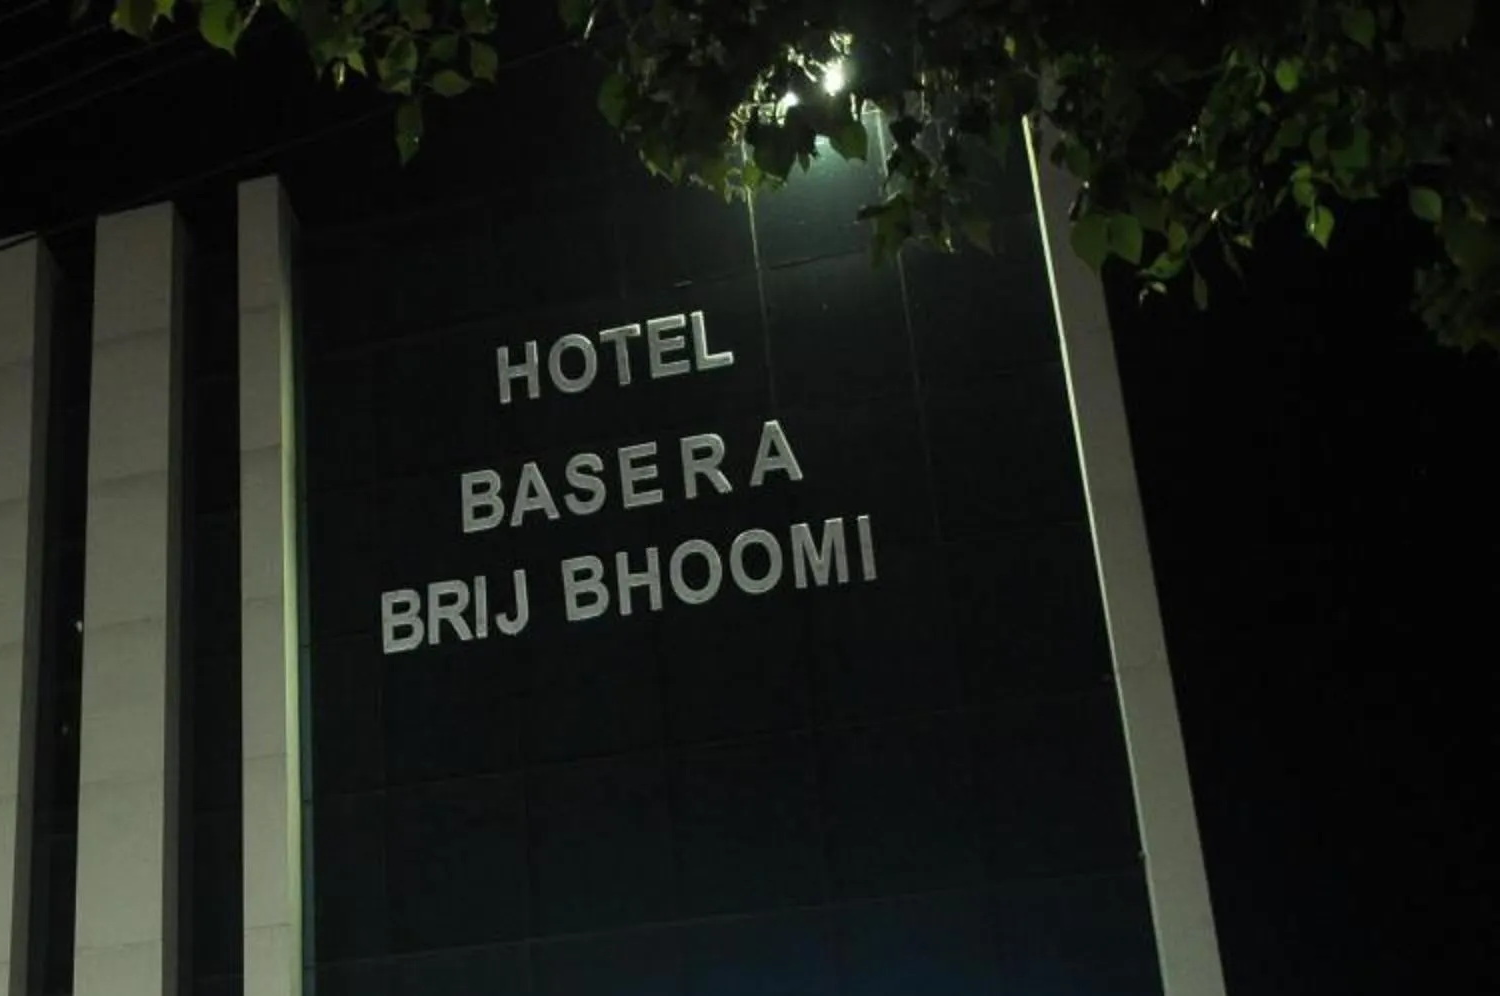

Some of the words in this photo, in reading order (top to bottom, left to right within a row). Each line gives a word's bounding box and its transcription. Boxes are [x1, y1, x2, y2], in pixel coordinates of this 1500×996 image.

[496, 309, 735, 404] HOTEL
[460, 419, 803, 534] BASERA
[380, 568, 530, 655] BRIJ
[560, 513, 878, 622] BHOOMI
